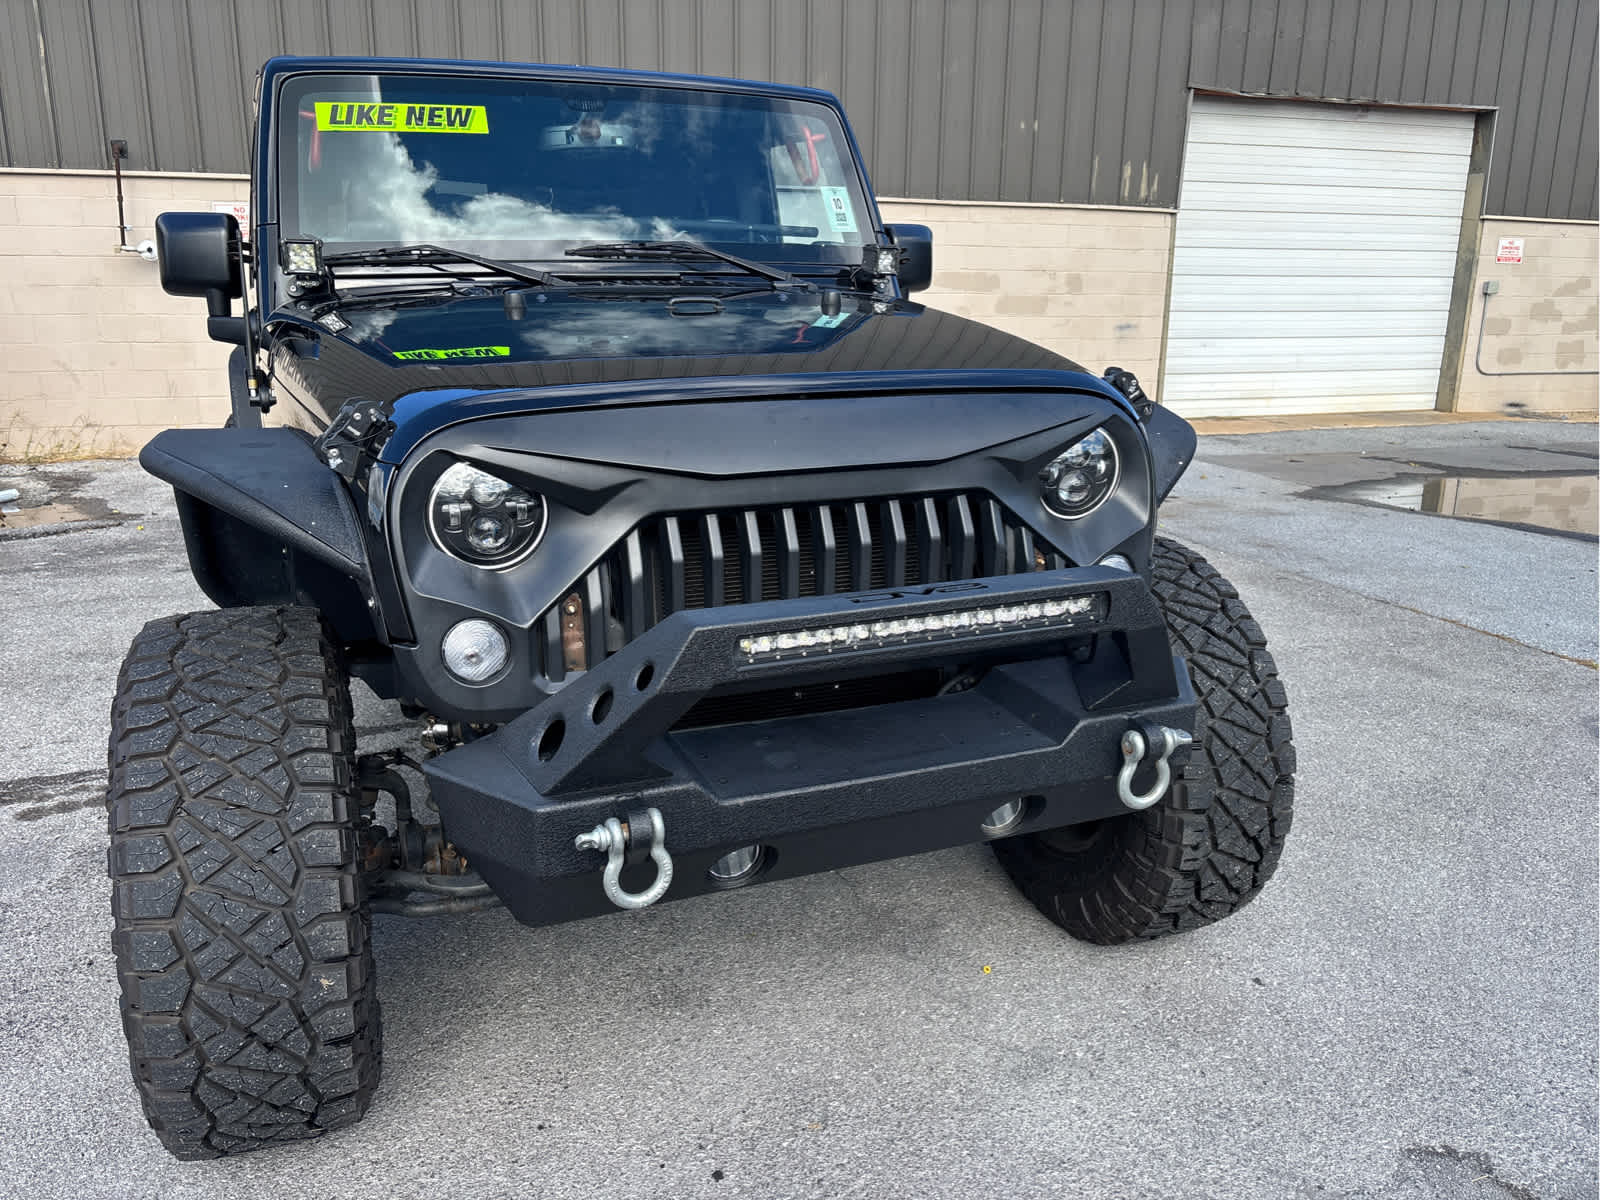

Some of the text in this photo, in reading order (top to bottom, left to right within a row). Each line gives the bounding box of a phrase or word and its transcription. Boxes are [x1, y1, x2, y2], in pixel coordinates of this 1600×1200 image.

[329, 104, 473, 128] LIKE NEW
[233, 206, 246, 214] NO
